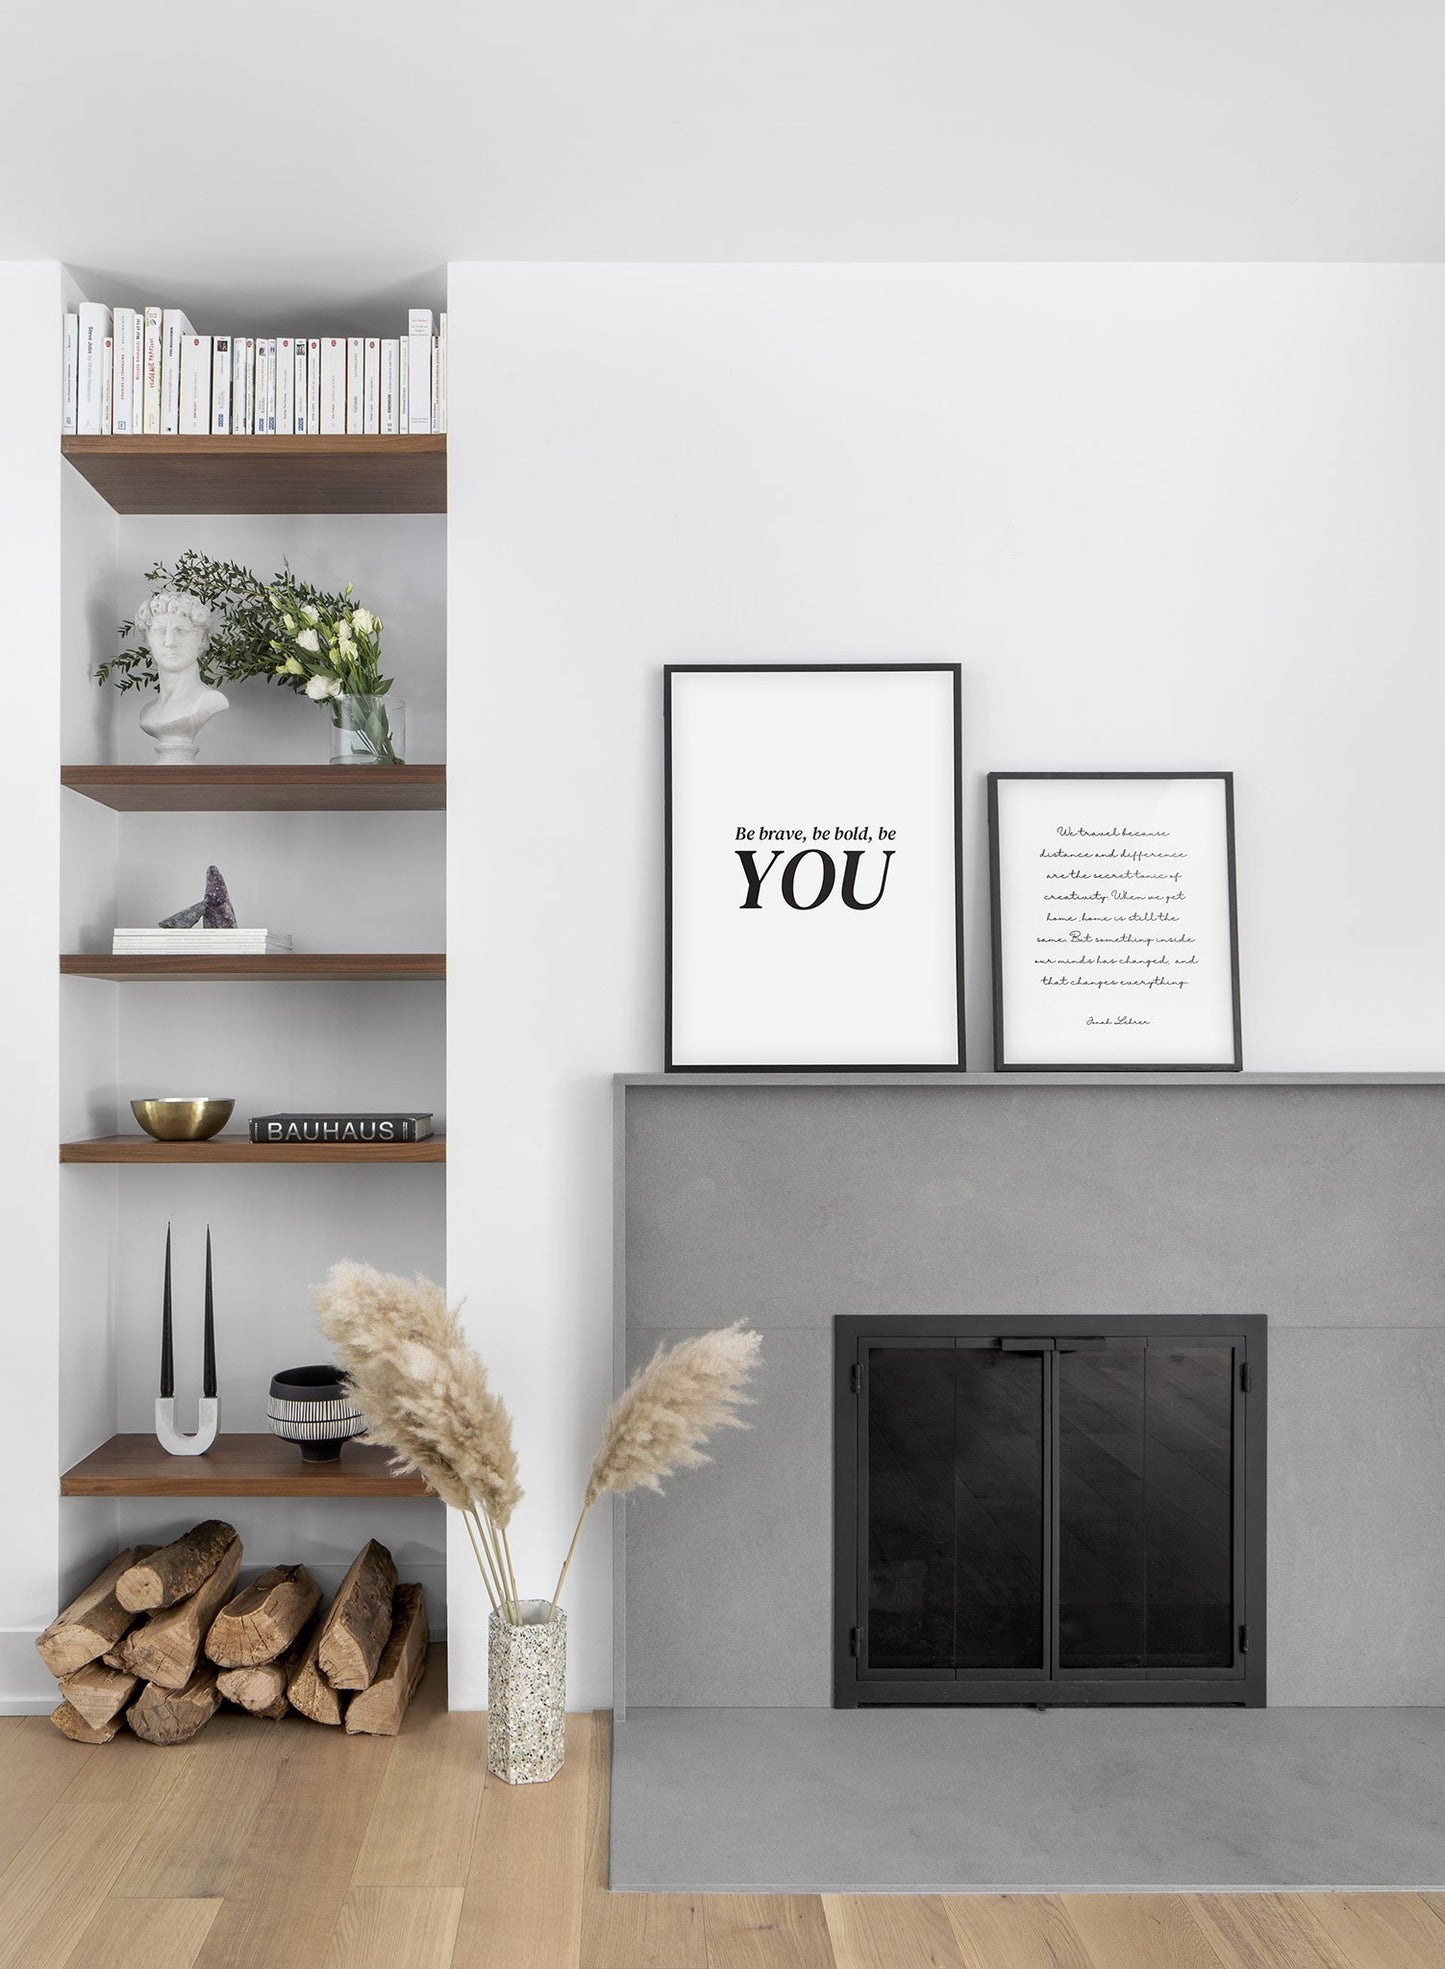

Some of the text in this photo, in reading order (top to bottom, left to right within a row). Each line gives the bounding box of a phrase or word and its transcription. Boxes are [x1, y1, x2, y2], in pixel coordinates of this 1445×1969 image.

[735, 826, 896, 843] Be brave, be bold, be
[1057, 826, 1170, 836] We travel because
[1040, 849, 1187, 861] distance and difference
[735, 849, 896, 910] YOU
[1069, 870, 1092, 879] the
[1093, 870, 1132, 879] secret
[1131, 870, 1167, 879] tonic
[1170, 872, 1182, 882] of
[1111, 890, 1146, 900] When
[1166, 891, 1186, 903] get
[1128, 912, 1156, 921] still
[1156, 912, 1180, 921] the
[1069, 930, 1093, 942] But
[1095, 933, 1154, 946] something
[1156, 934, 1195, 942] inside
[1058, 955, 1095, 964] minds
[1097, 955, 1117, 964] has
[1119, 955, 1170, 967] changed,
[1175, 955, 1199, 964] and
[1041, 976, 1069, 985] that
[1070, 977, 1118, 989] changes
[1114, 1016, 1150, 1025] Lehrer
[268, 1121, 394, 1141] BAUHAUS
